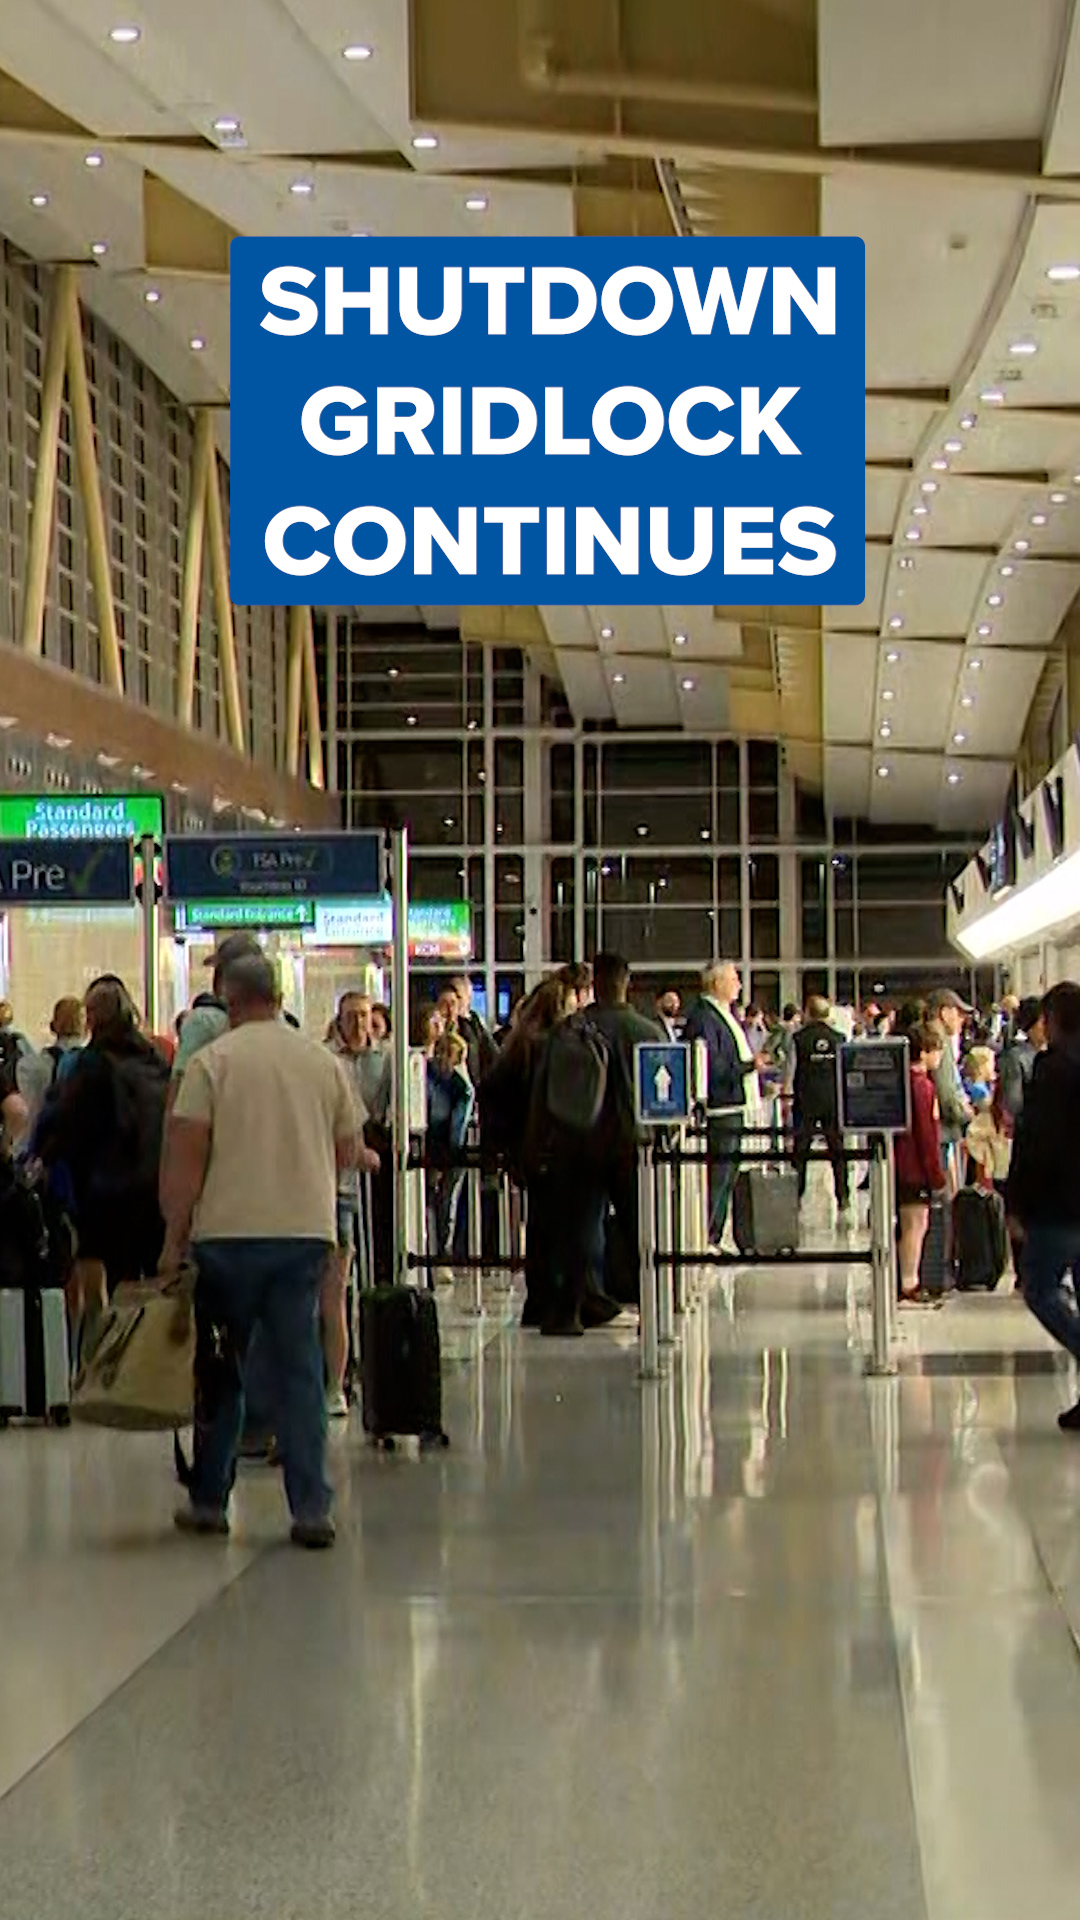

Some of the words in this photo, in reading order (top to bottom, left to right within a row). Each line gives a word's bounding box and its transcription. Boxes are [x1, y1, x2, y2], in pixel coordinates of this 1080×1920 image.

[35, 802, 124, 820] Standard
[12, 860, 65, 890] Pre
[323, 912, 385, 926] Standard
